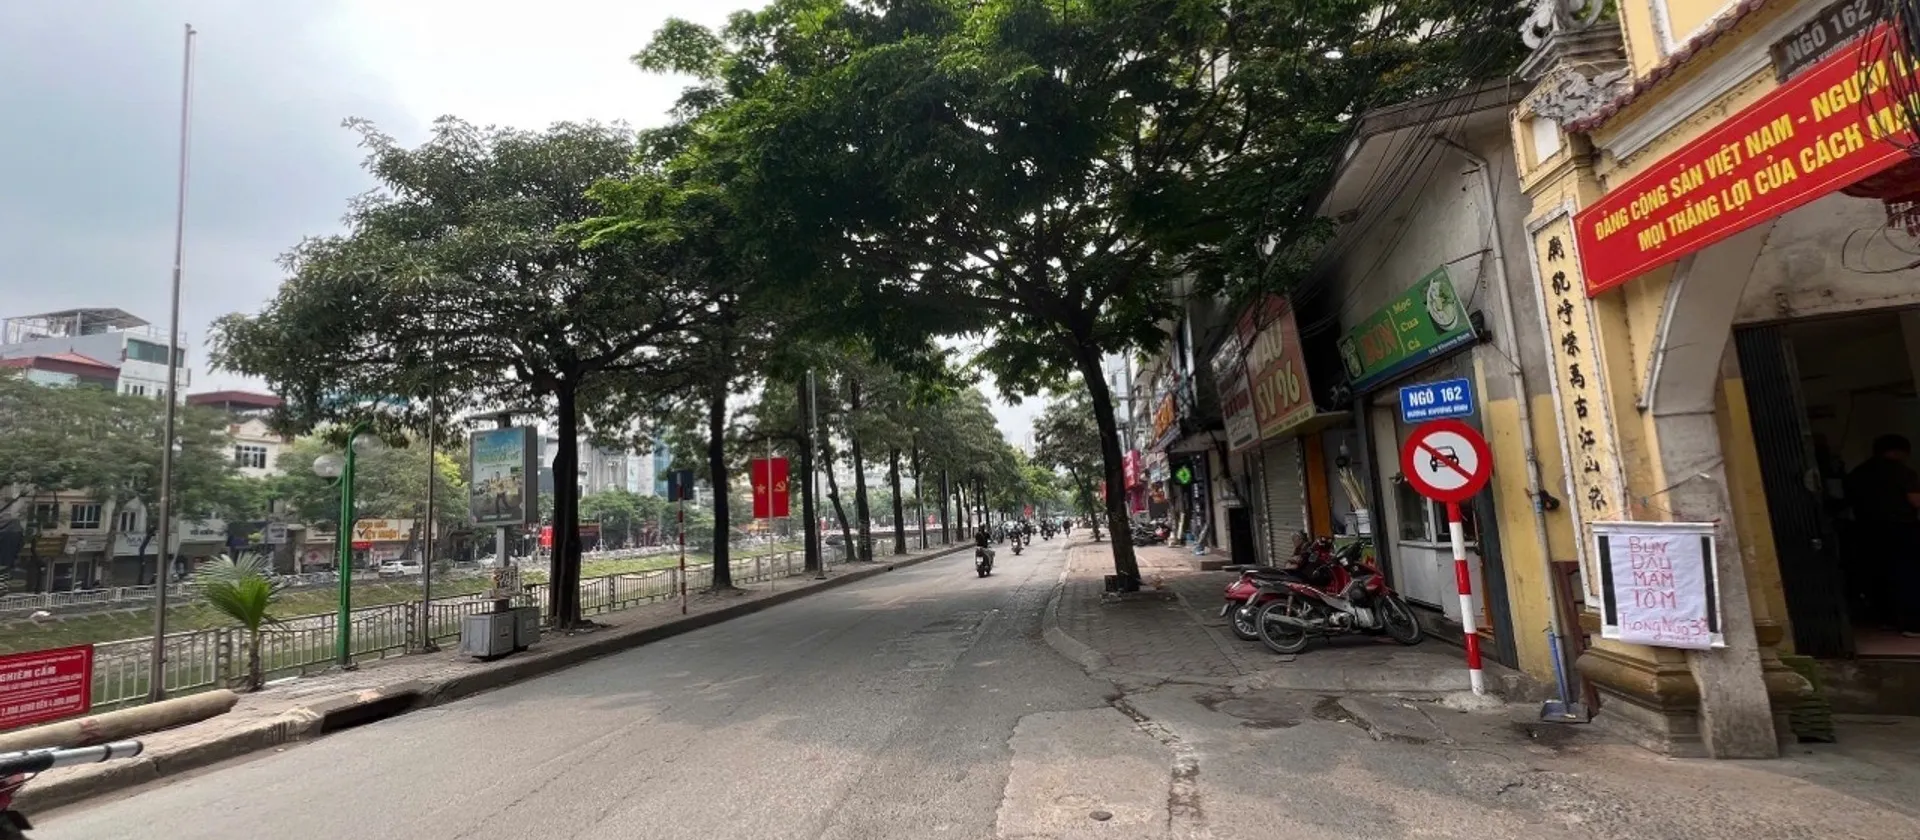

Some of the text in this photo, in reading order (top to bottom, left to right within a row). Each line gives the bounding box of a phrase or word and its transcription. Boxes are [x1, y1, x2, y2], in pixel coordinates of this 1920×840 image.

[1830, 0, 1872, 34] 162
[1594, 210, 1629, 241] ĐẢNG
[1630, 185, 1669, 220] CỘNG
[1670, 163, 1704, 198] SẢN
[1705, 144, 1742, 179] VIỆT
[1744, 114, 1794, 158] NAM
[1637, 222, 1668, 252] MỌI
[1667, 195, 1721, 237] THẮNG
[1721, 178, 1753, 212] LỢI
[1756, 154, 1798, 196] CỦA
[1799, 123, 1865, 173] CÁCH
[1400, 317, 1419, 332] Cua
[1407, 337, 1421, 351] Cá
[1256, 373, 1276, 421] SV
[1277, 360, 1301, 409] 96
[1409, 386, 1463, 407] NGÕ 162
[34, 663, 57, 677] CẤM
